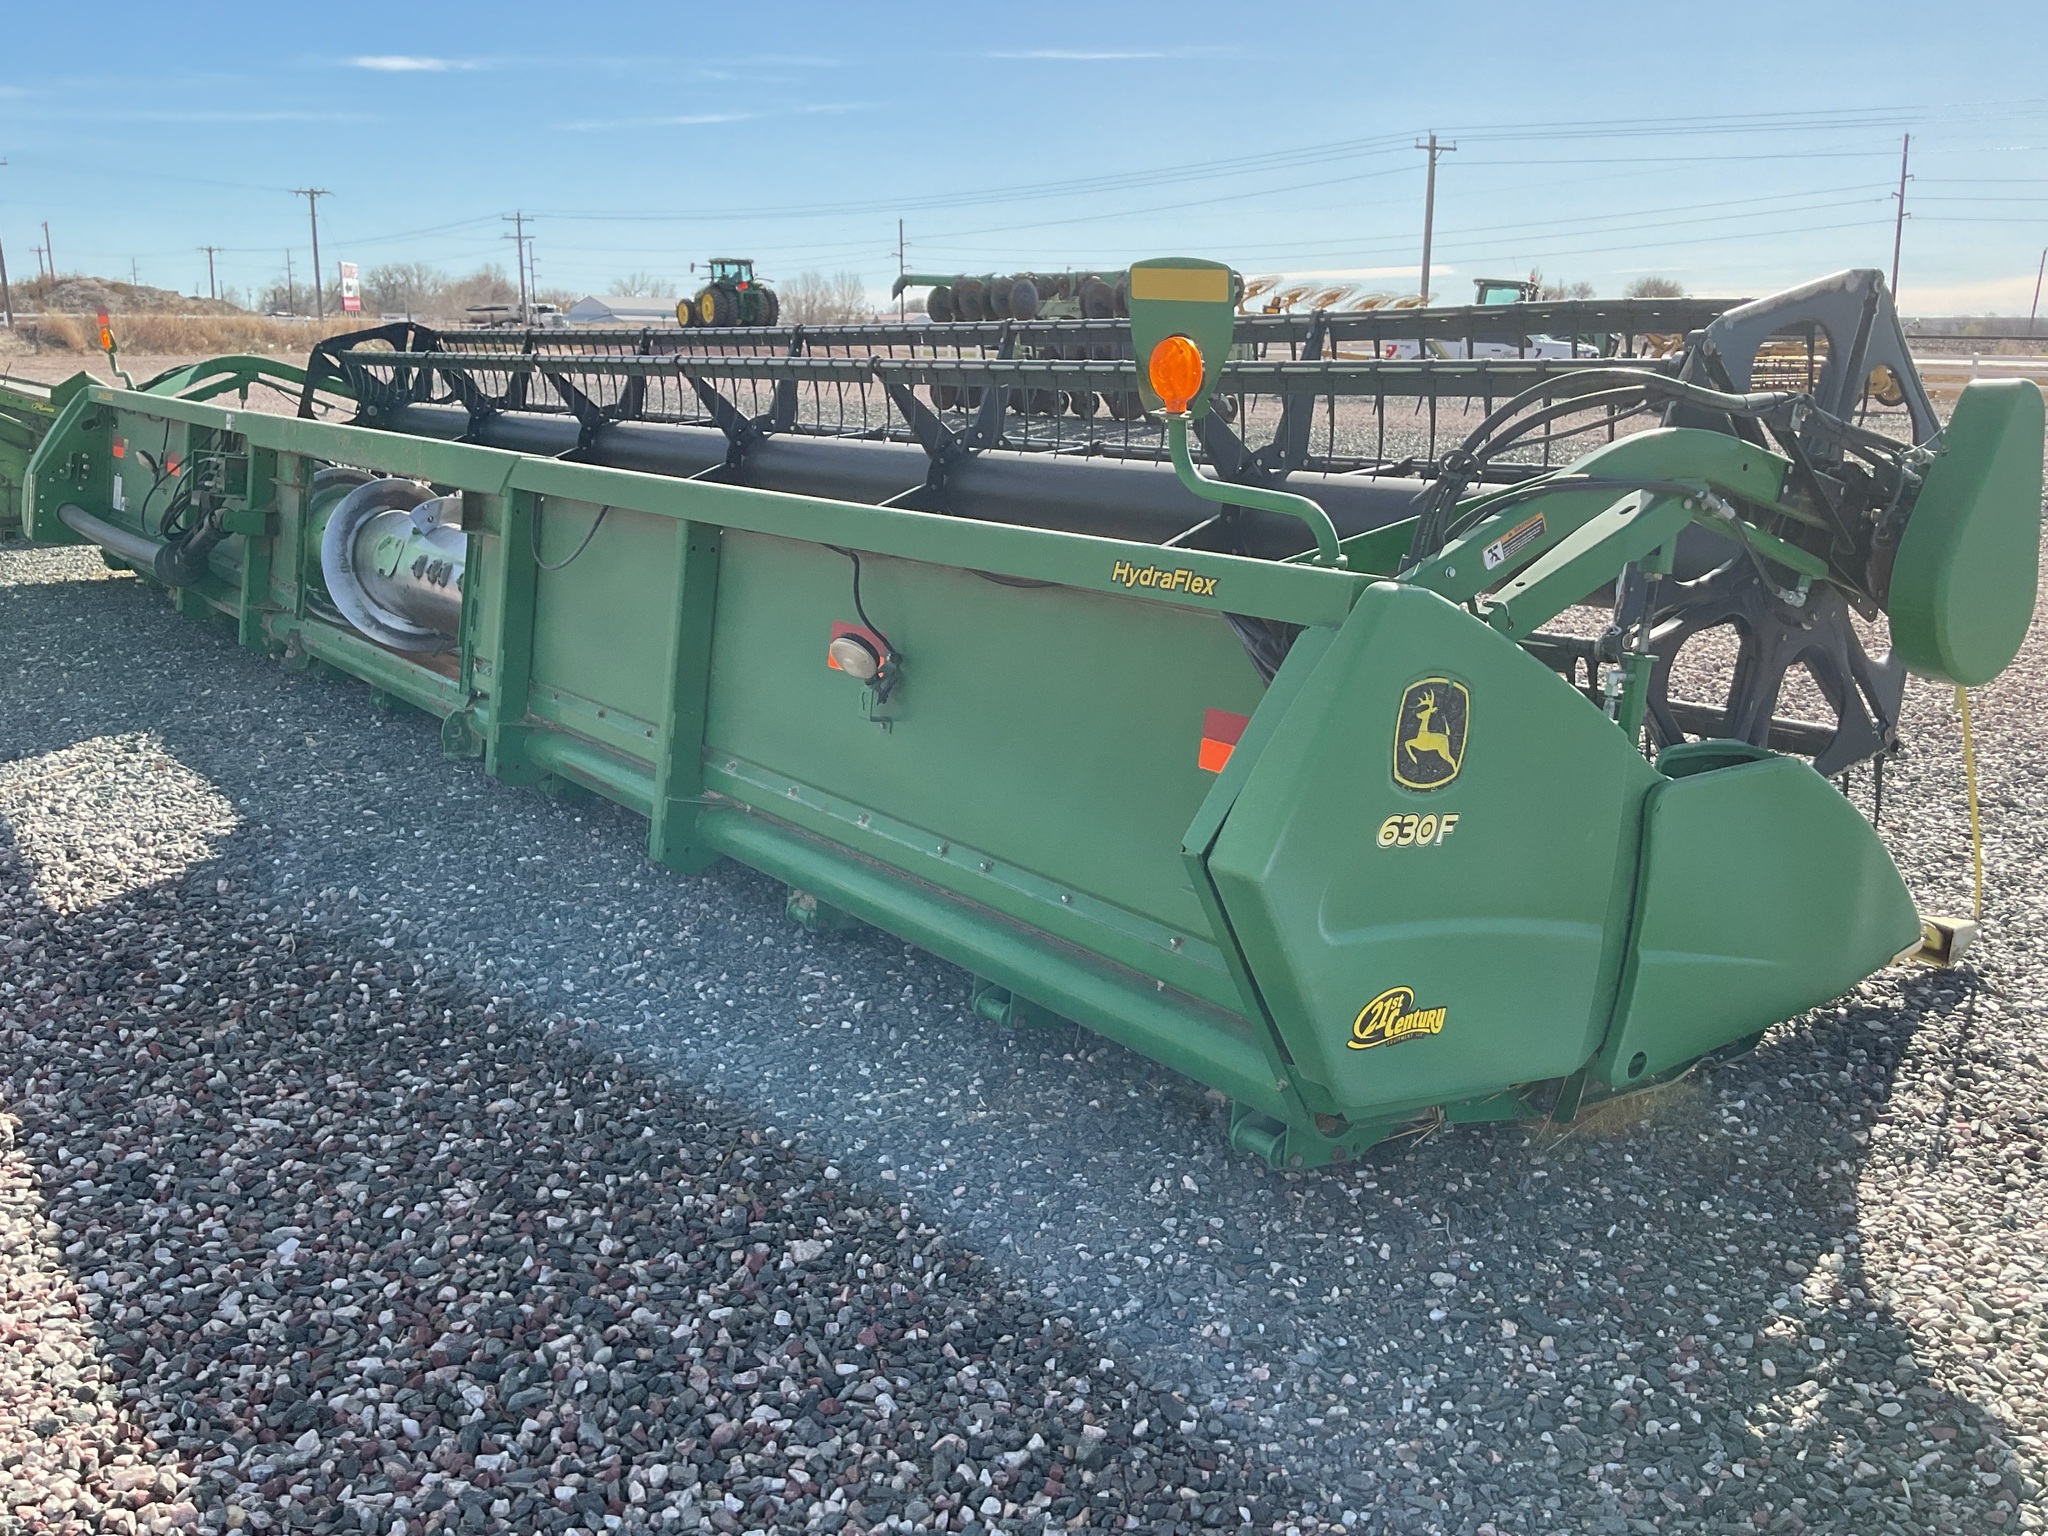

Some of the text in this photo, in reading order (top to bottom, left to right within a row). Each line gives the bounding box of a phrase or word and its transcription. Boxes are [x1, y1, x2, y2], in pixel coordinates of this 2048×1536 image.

[1111, 560, 1218, 596] HydraFlex
[1377, 812, 1461, 848] 630F
[1361, 993, 1405, 1036] 21st
